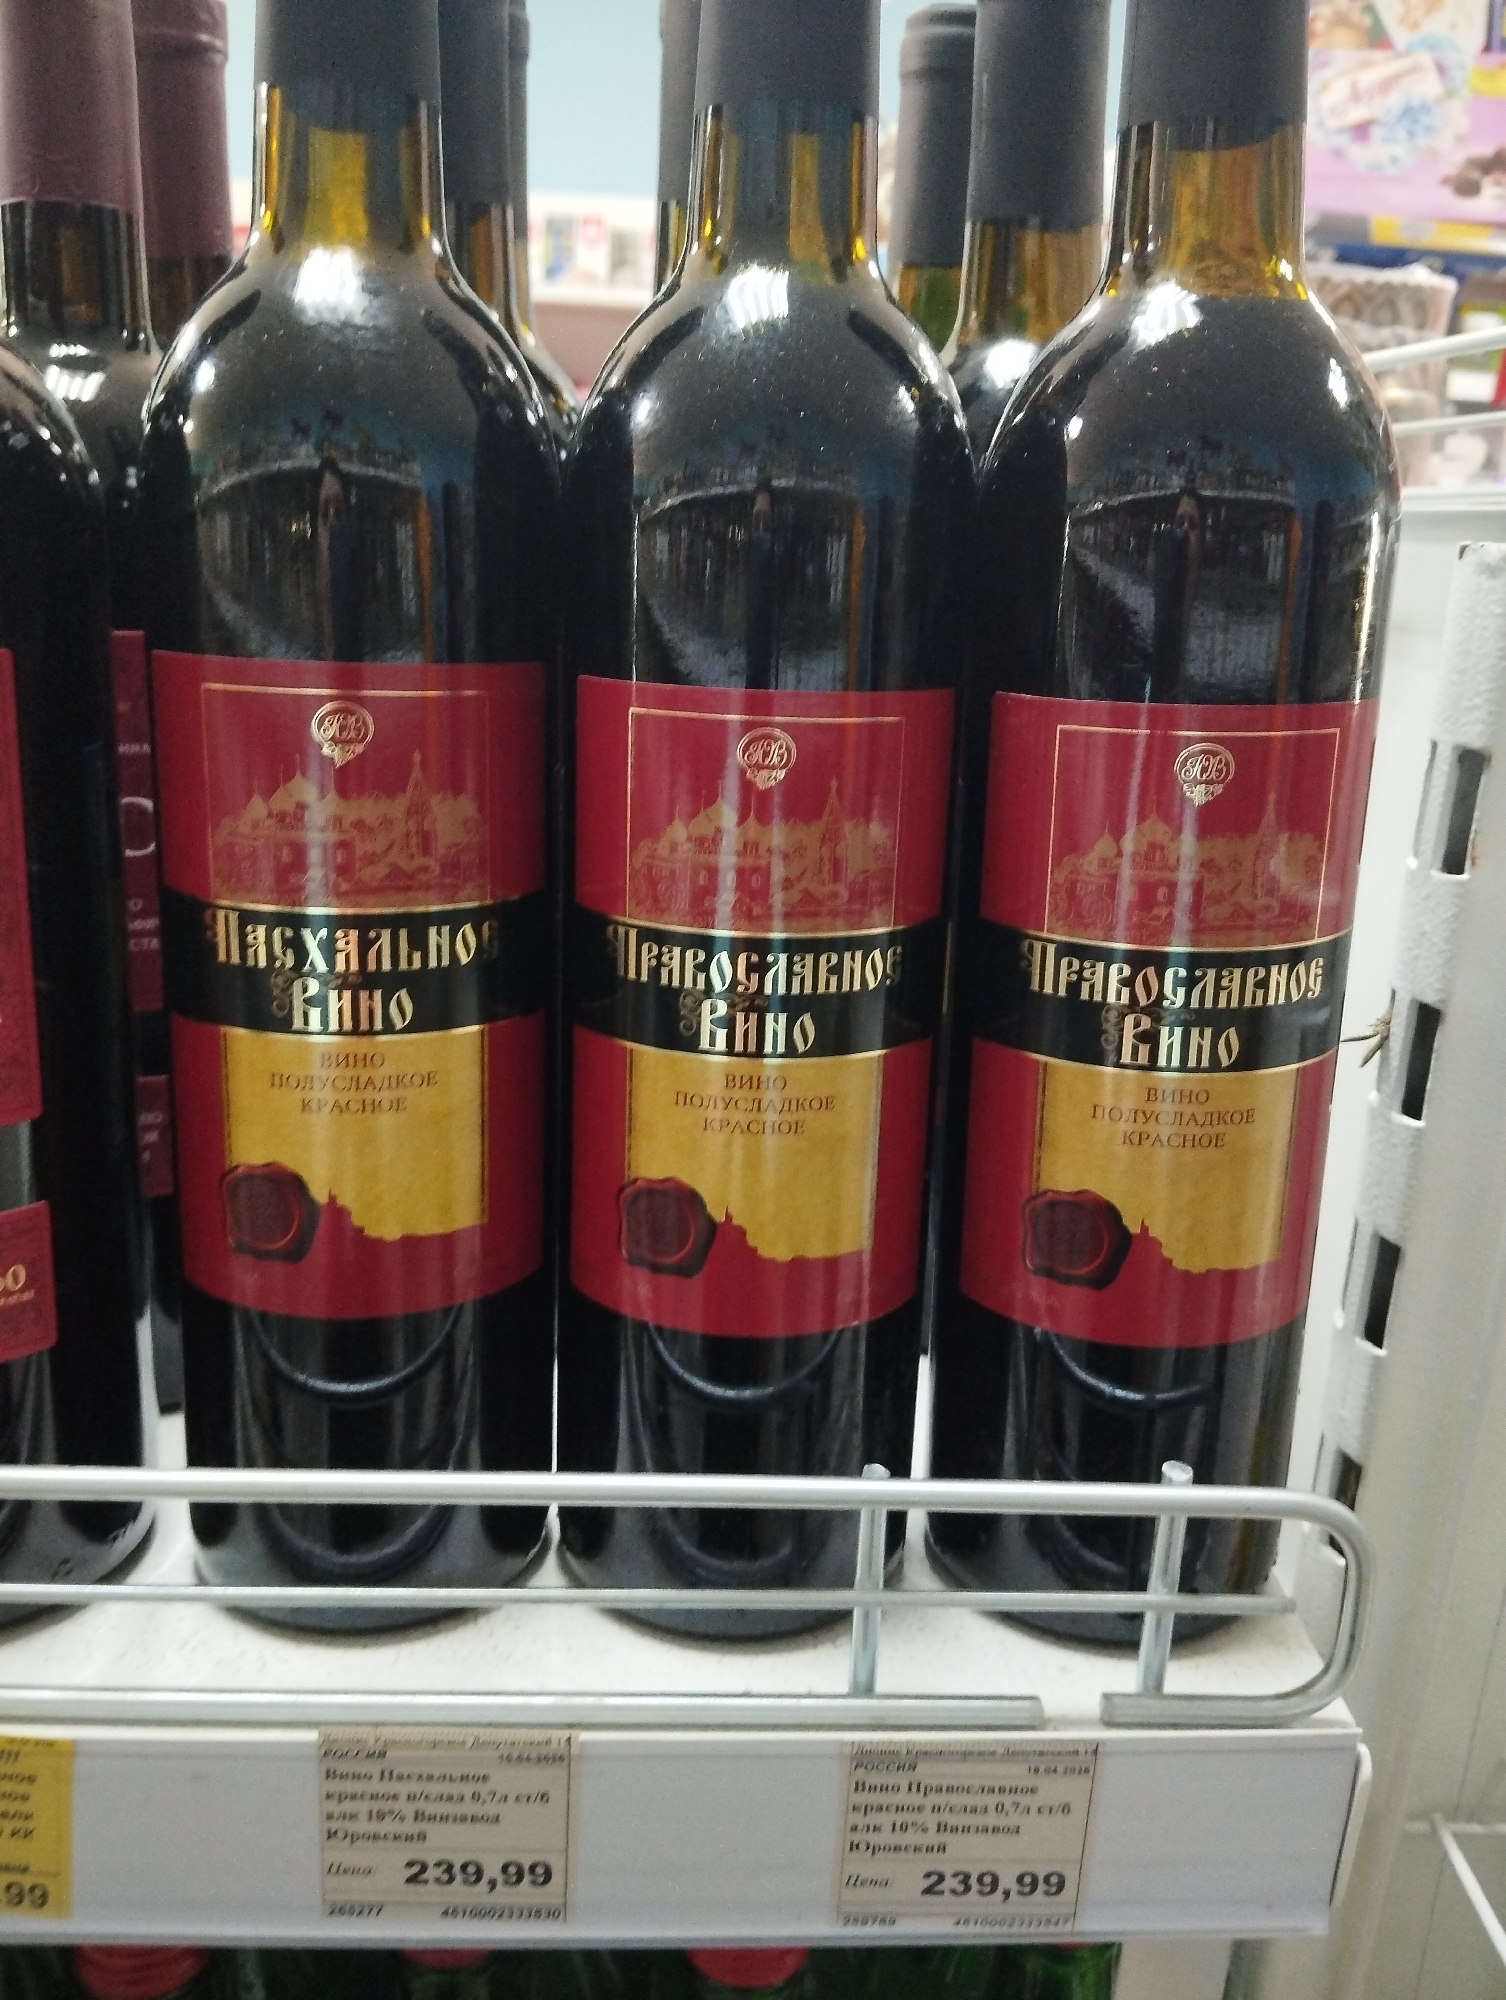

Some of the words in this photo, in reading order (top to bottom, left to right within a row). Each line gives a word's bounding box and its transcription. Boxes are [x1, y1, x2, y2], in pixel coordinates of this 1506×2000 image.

[290, 976, 414, 1033] Вино
[699, 998, 816, 1055] Вино
[1118, 1012, 1241, 1069] Вино
[319, 1050, 386, 1070] ВИНО
[269, 1069, 439, 1092] ПОЛУСЛАДКОЕ
[724, 1073, 788, 1091] ВИНО
[674, 1090, 836, 1113] ПОЛУСЛАДКОЕ
[1145, 1087, 1211, 1104] ВИНО
[300, 1097, 409, 1115] КРАСНОЕ
[1091, 1103, 1256, 1127] ПОЛУСЛАДКОЕ
[702, 1117, 805, 1136] КРАСНОЕ
[1121, 1130, 1227, 1149] КРАСНОЕ
[325, 1768, 374, 1782] Вино
[379, 1768, 490, 1784] Пасхальное
[853, 1761, 918, 1773] РОССИЯ
[325, 1790, 400, 1805] красное
[853, 1780, 901, 1795] Вино
[905, 1780, 1039, 1798] Православное
[413, 1808, 502, 1825] Винзавод
[851, 1802, 925, 1817] красное
[994, 1801, 1031, 1817] 0,7л
[325, 1827, 428, 1845] Юровский
[849, 1823, 884, 1835] алк
[890, 1821, 930, 1836] 10%
[935, 1820, 1022, 1836] Винзавод
[847, 1840, 948, 1857] Юровский
[403, 1858, 553, 1894] 239,99
[920, 1869, 1066, 1902] 239,99
